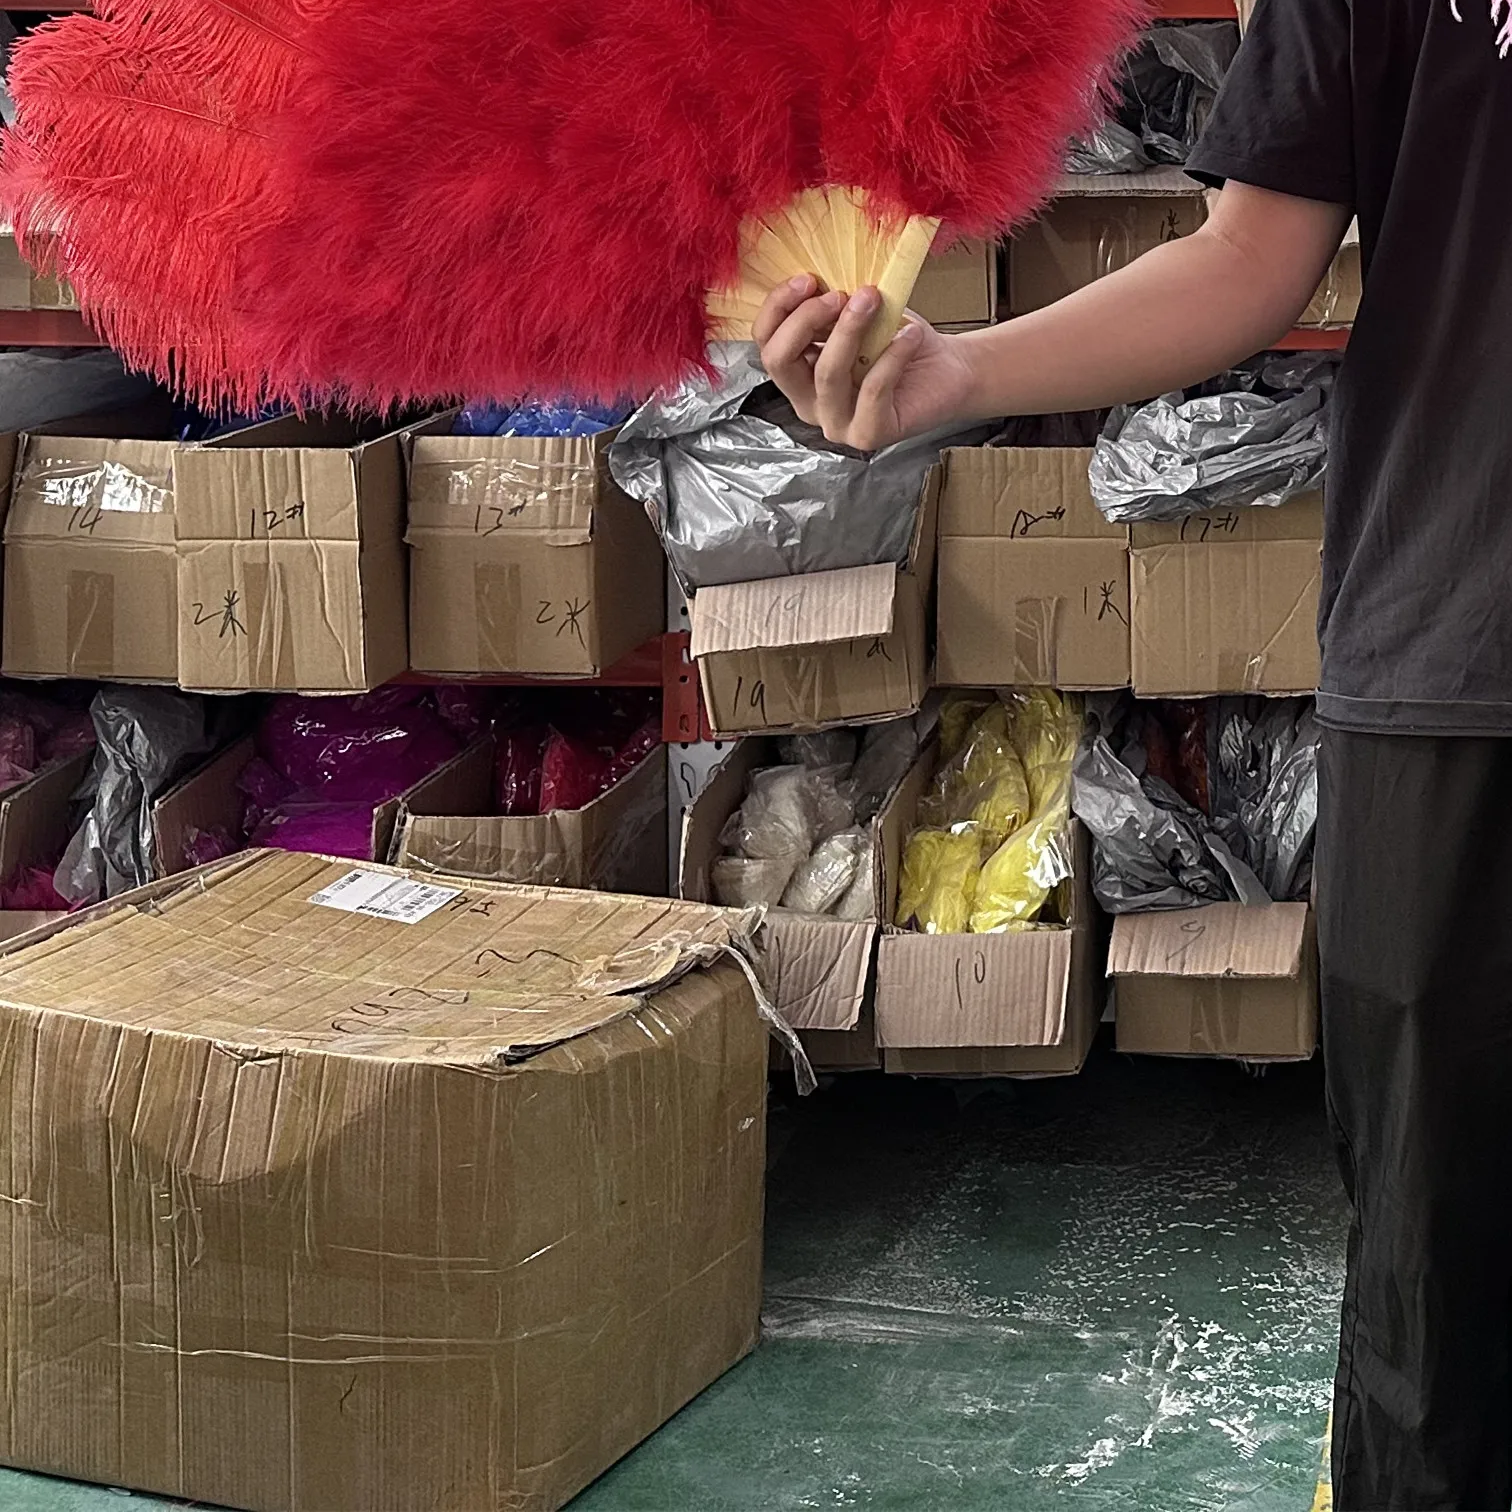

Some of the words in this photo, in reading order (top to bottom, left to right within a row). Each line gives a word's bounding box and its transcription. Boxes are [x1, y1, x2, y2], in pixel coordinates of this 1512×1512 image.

[67, 506, 103, 535] 14
[250, 501, 305, 538] 12#
[192, 590, 248, 638] 2米
[536, 597, 591, 651] 2米
[1083, 580, 1129, 627] 1米
[732, 675, 769, 725] 19
[954, 949, 986, 1011] 10
